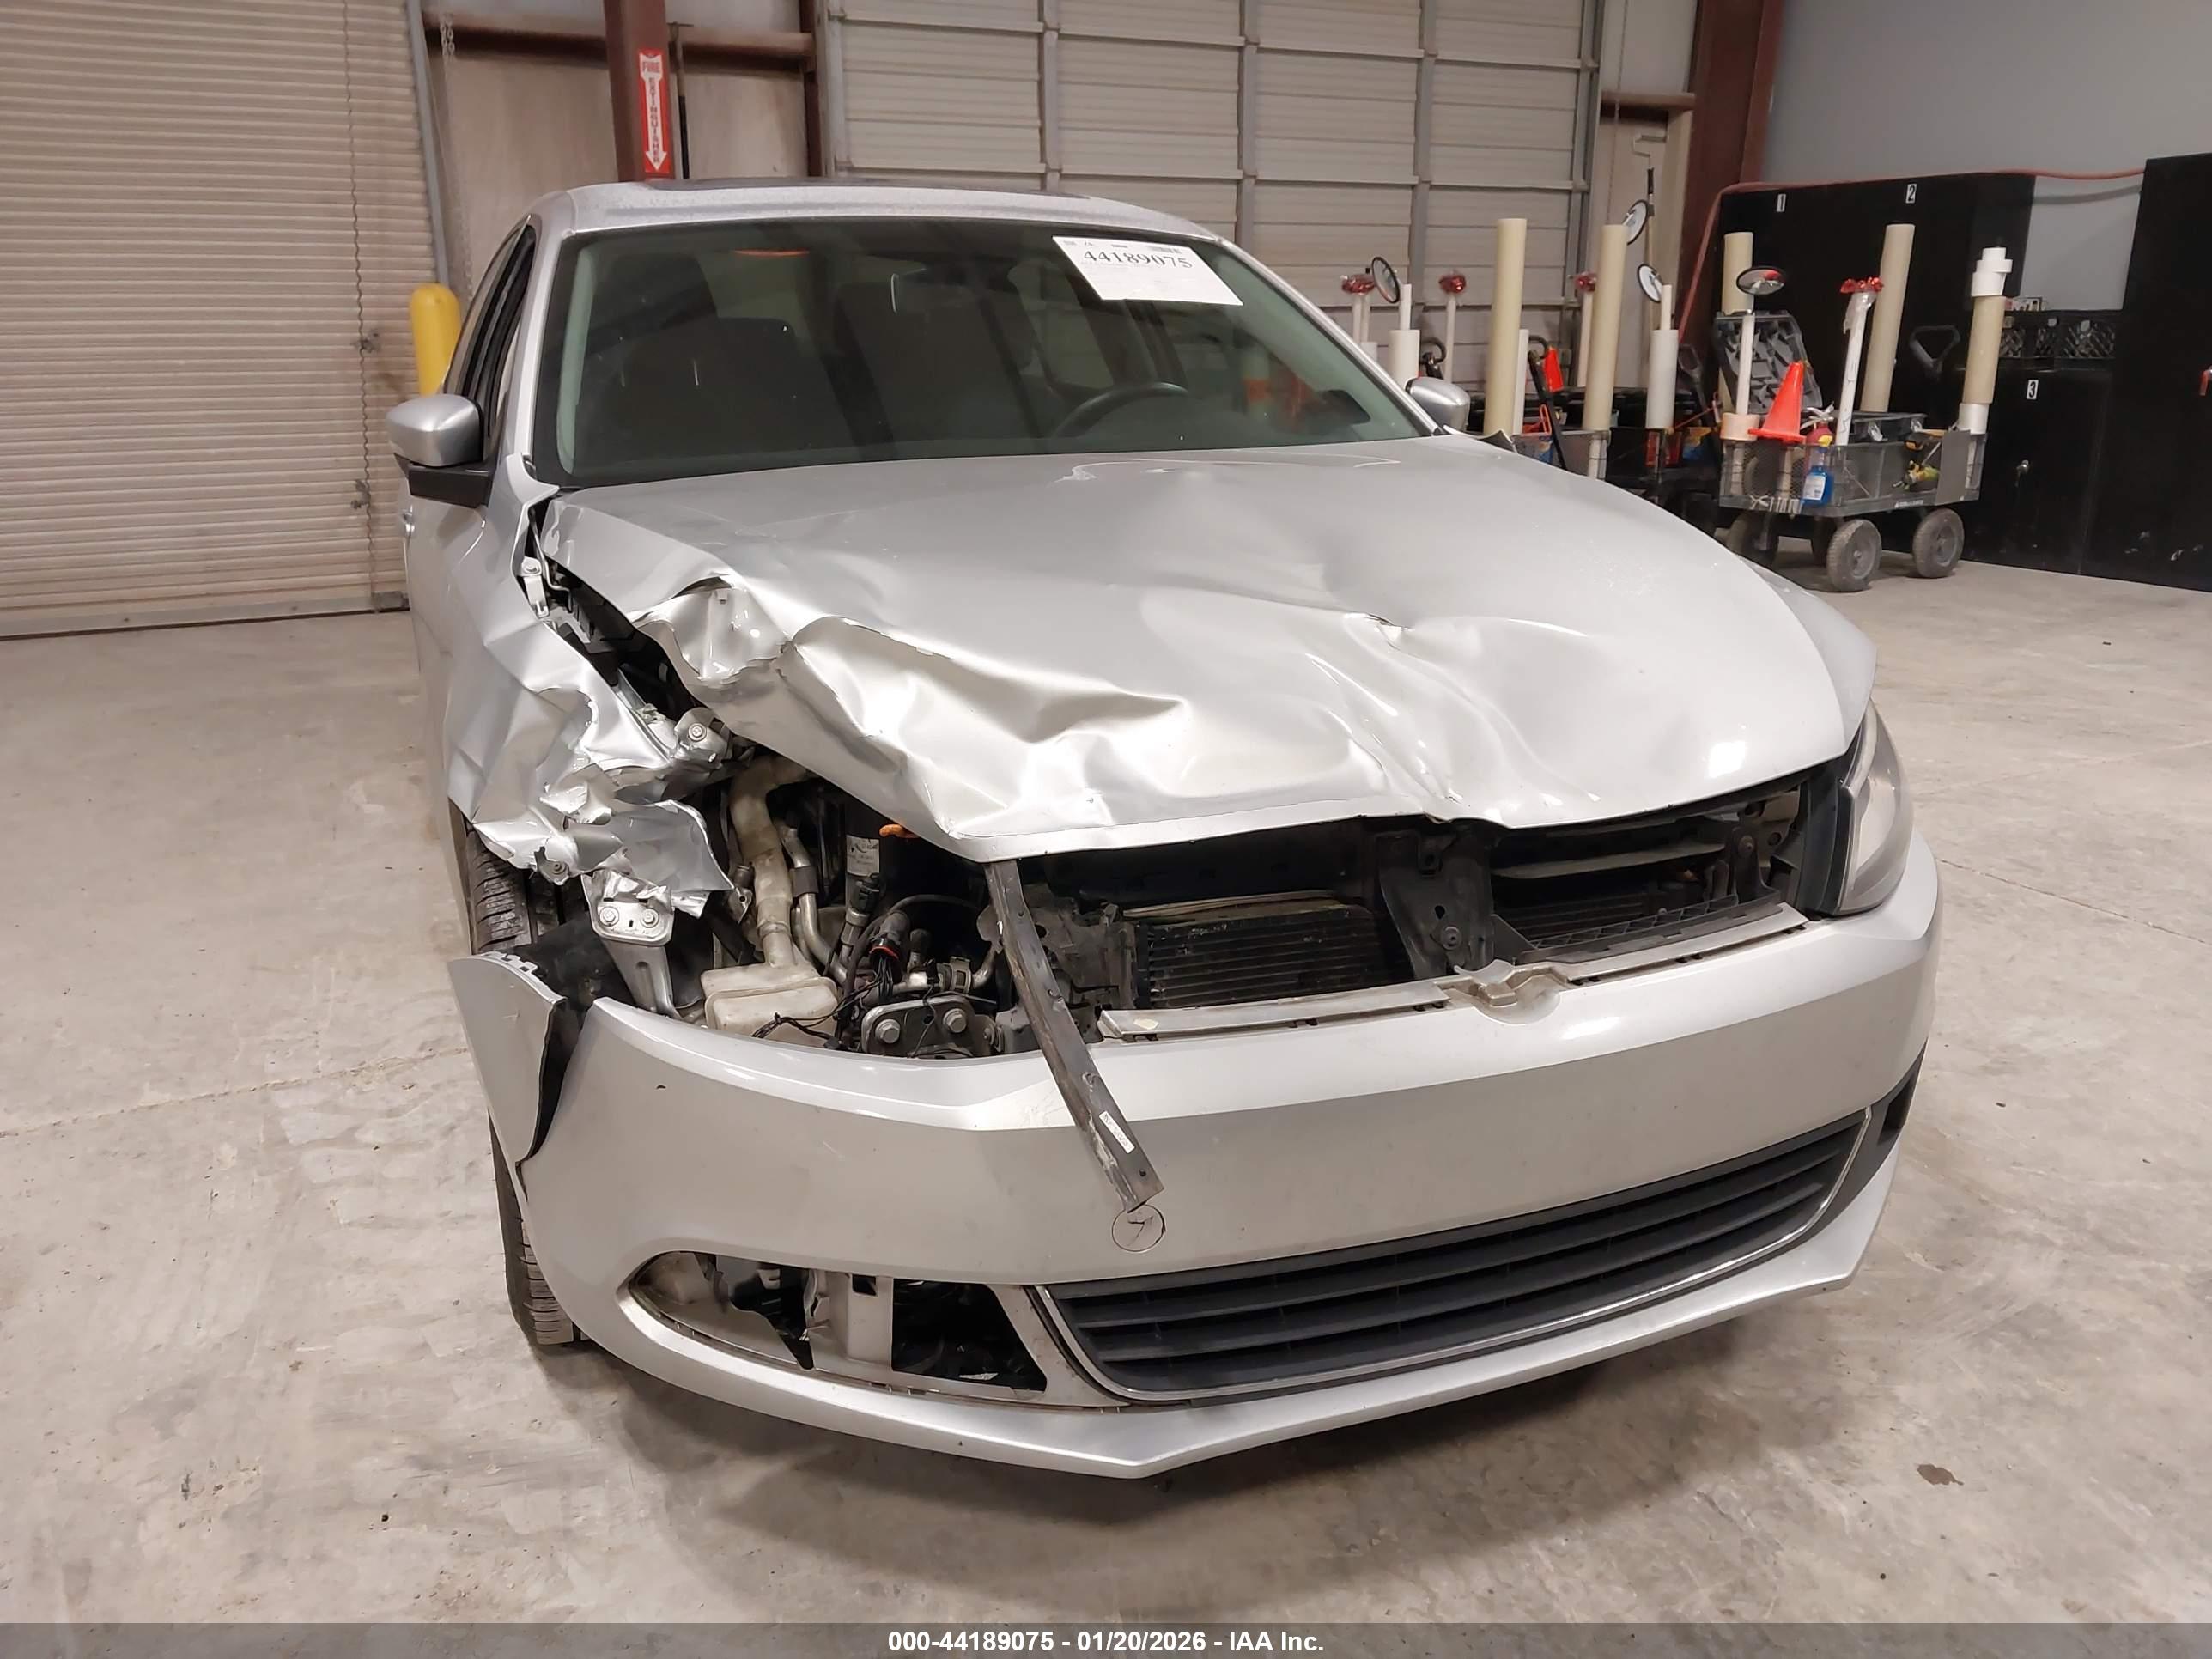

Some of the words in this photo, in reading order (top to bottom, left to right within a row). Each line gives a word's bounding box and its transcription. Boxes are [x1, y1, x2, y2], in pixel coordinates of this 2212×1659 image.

[642, 62, 660, 73] FIRE
[1907, 185, 1916, 202] 2
[1084, 250, 1193, 268] 44189075
[2028, 381, 2037, 398] 3
